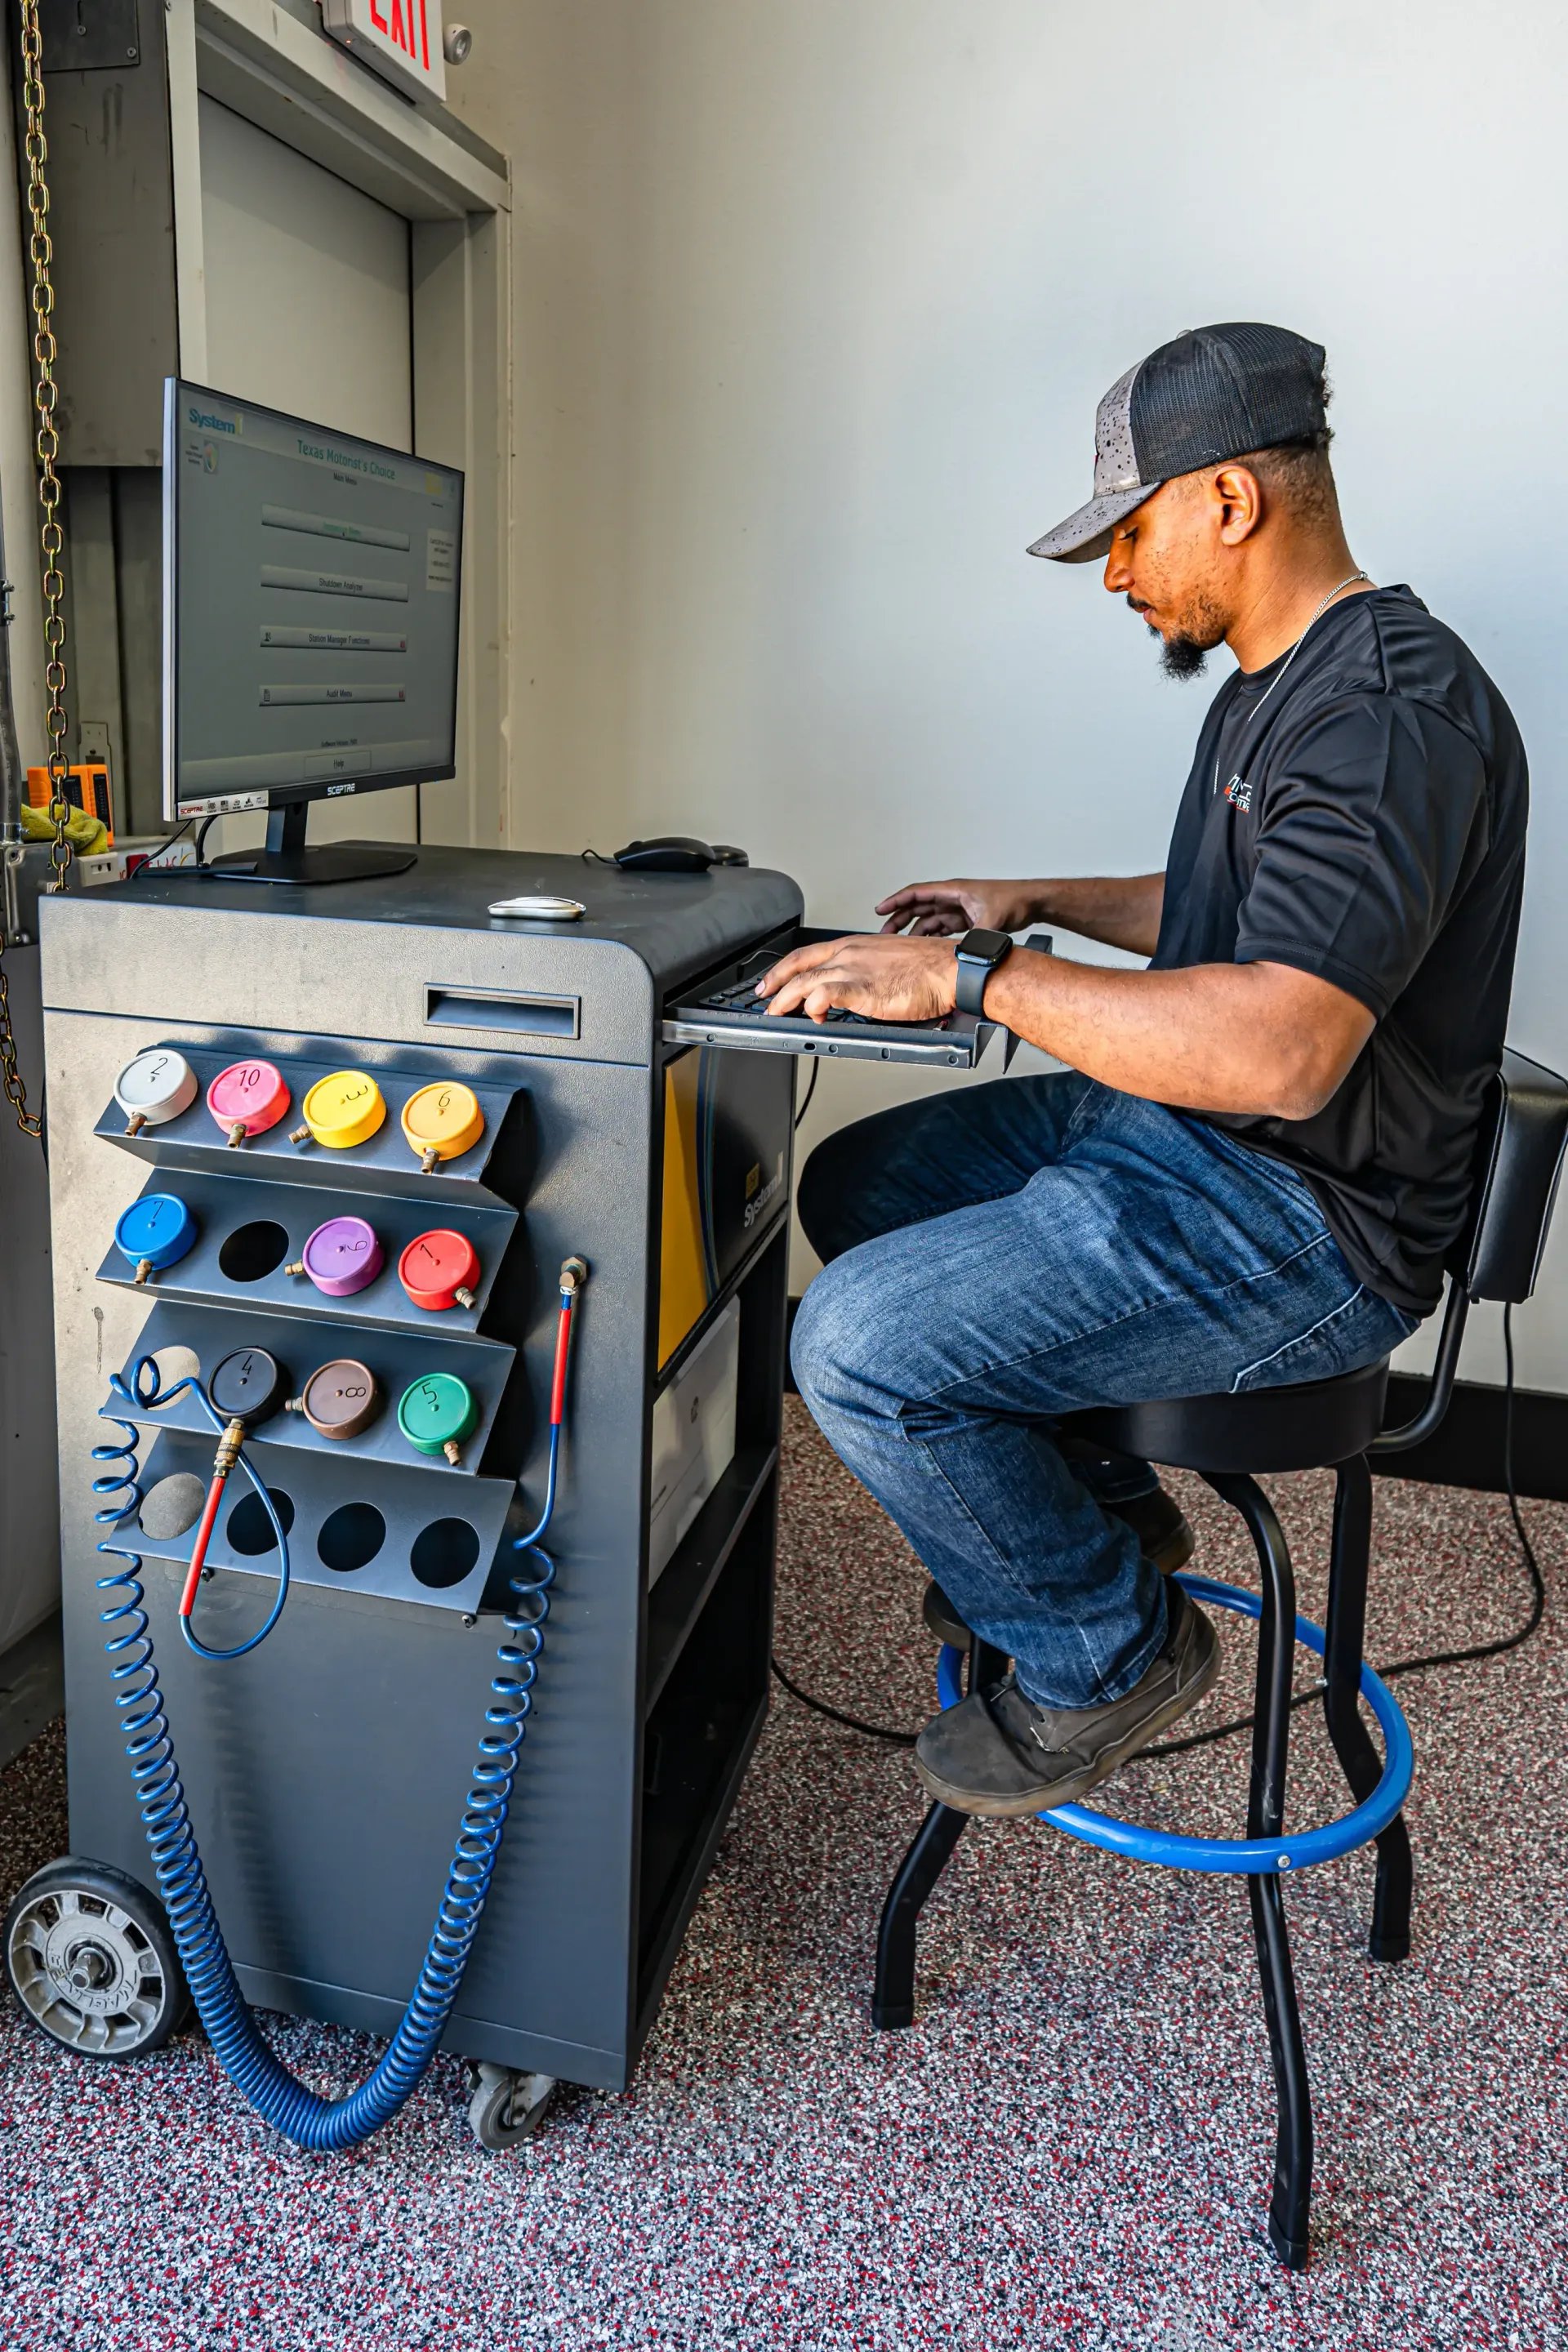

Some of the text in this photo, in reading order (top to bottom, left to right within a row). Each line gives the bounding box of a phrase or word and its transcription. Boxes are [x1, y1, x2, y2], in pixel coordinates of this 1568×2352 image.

[297, 439, 324, 460] Texas
[370, 461, 395, 479] Choice
[327, 782, 355, 796] SCEPTRE
[180, 805, 203, 815] SCEPTRE
[150, 1057, 168, 1076] 2
[239, 1068, 261, 1087] 10
[438, 1089, 452, 1107] 6
[154, 1200, 165, 1220] 7
[241, 1354, 253, 1375] 4
[345, 1387, 367, 1398] 8
[421, 1382, 438, 1405] 5
